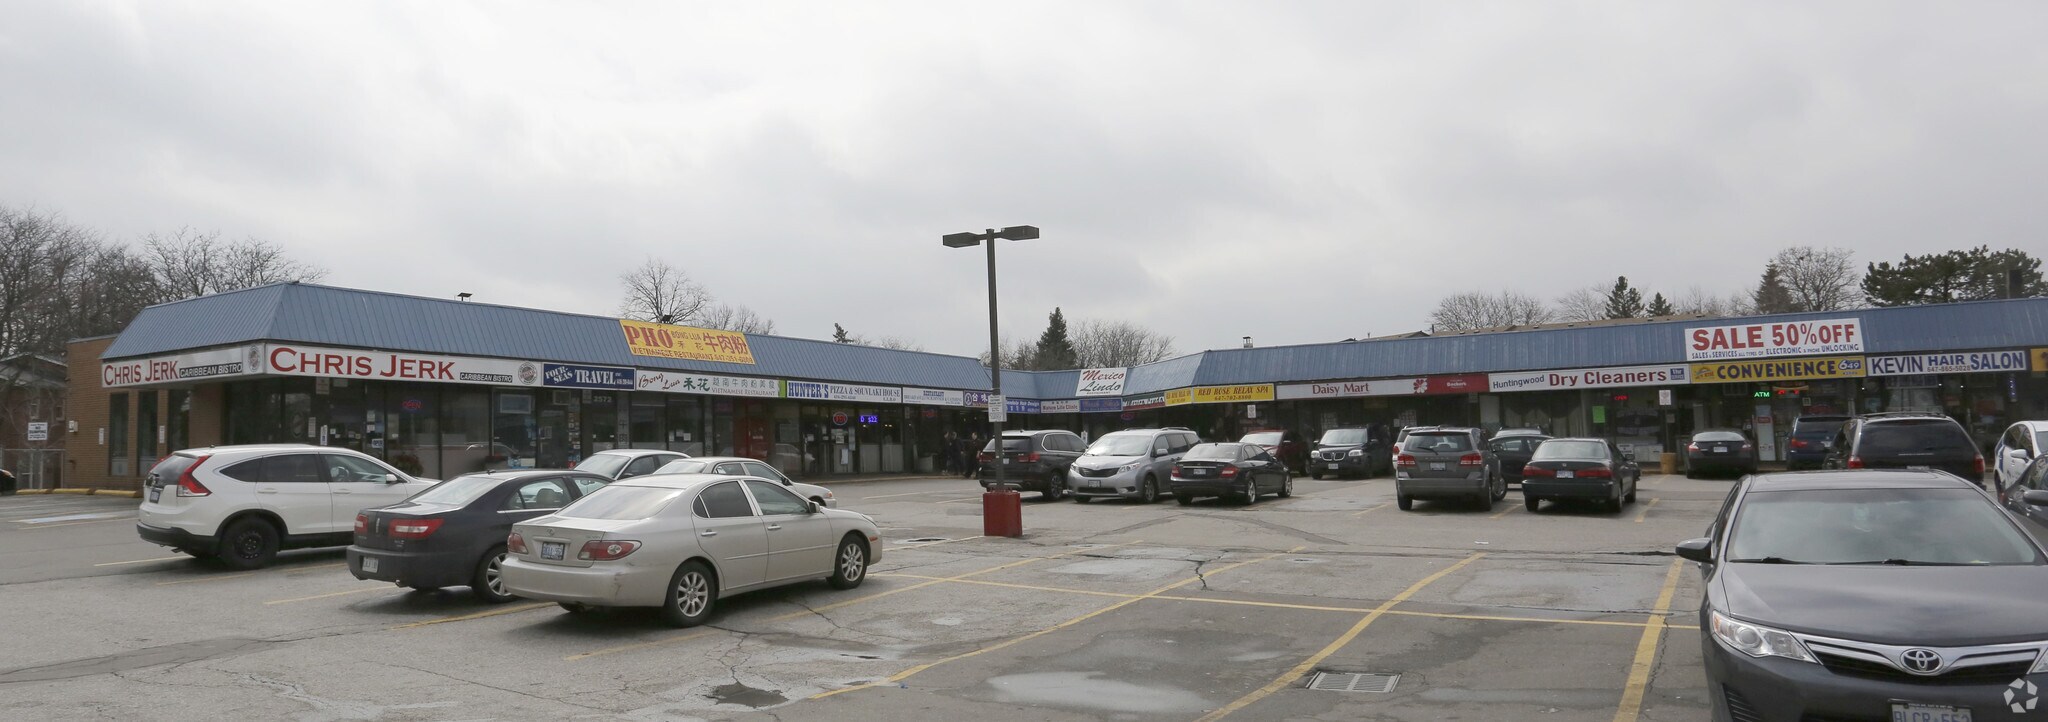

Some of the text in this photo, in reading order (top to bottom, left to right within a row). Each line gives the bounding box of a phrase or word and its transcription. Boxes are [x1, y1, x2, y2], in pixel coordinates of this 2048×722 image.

[703, 332, 749, 354] 牛肉粉
[1692, 322, 1855, 351] SALE 50%OFF
[1691, 351, 1709, 359] SALES
[1712, 350, 1738, 358] SERVICES
[1766, 346, 1802, 355] ELECTRONIC
[1821, 343, 1859, 353] UNLOCKING
[180, 363, 242, 378] CARIBBEAN BISTRO
[269, 347, 456, 380] CHRIS JERK
[1716, 359, 1837, 380] CONVENIENCE
[1871, 351, 2024, 375] KEVIN HAIR SALON
[104, 360, 179, 386] CHRIS JERK
[460, 372, 513, 383] CARIBBEAN BISTRO
[575, 369, 616, 385] TRAVEL
[1082, 369, 1125, 382] Mexico
[1492, 370, 1667, 390] Huntingwood Dry Cleaners
[788, 381, 829, 399] HUNTER'S
[830, 385, 848, 395] PIZZA
[848, 387, 854, 395] &
[854, 387, 882, 397] SOUVLAKI
[882, 388, 901, 398] HOUSE
[1080, 380, 1122, 392] Lindo
[1198, 385, 1269, 396] RED ROSE RELAX SPA
[1312, 382, 1370, 397] Daisy Mart
